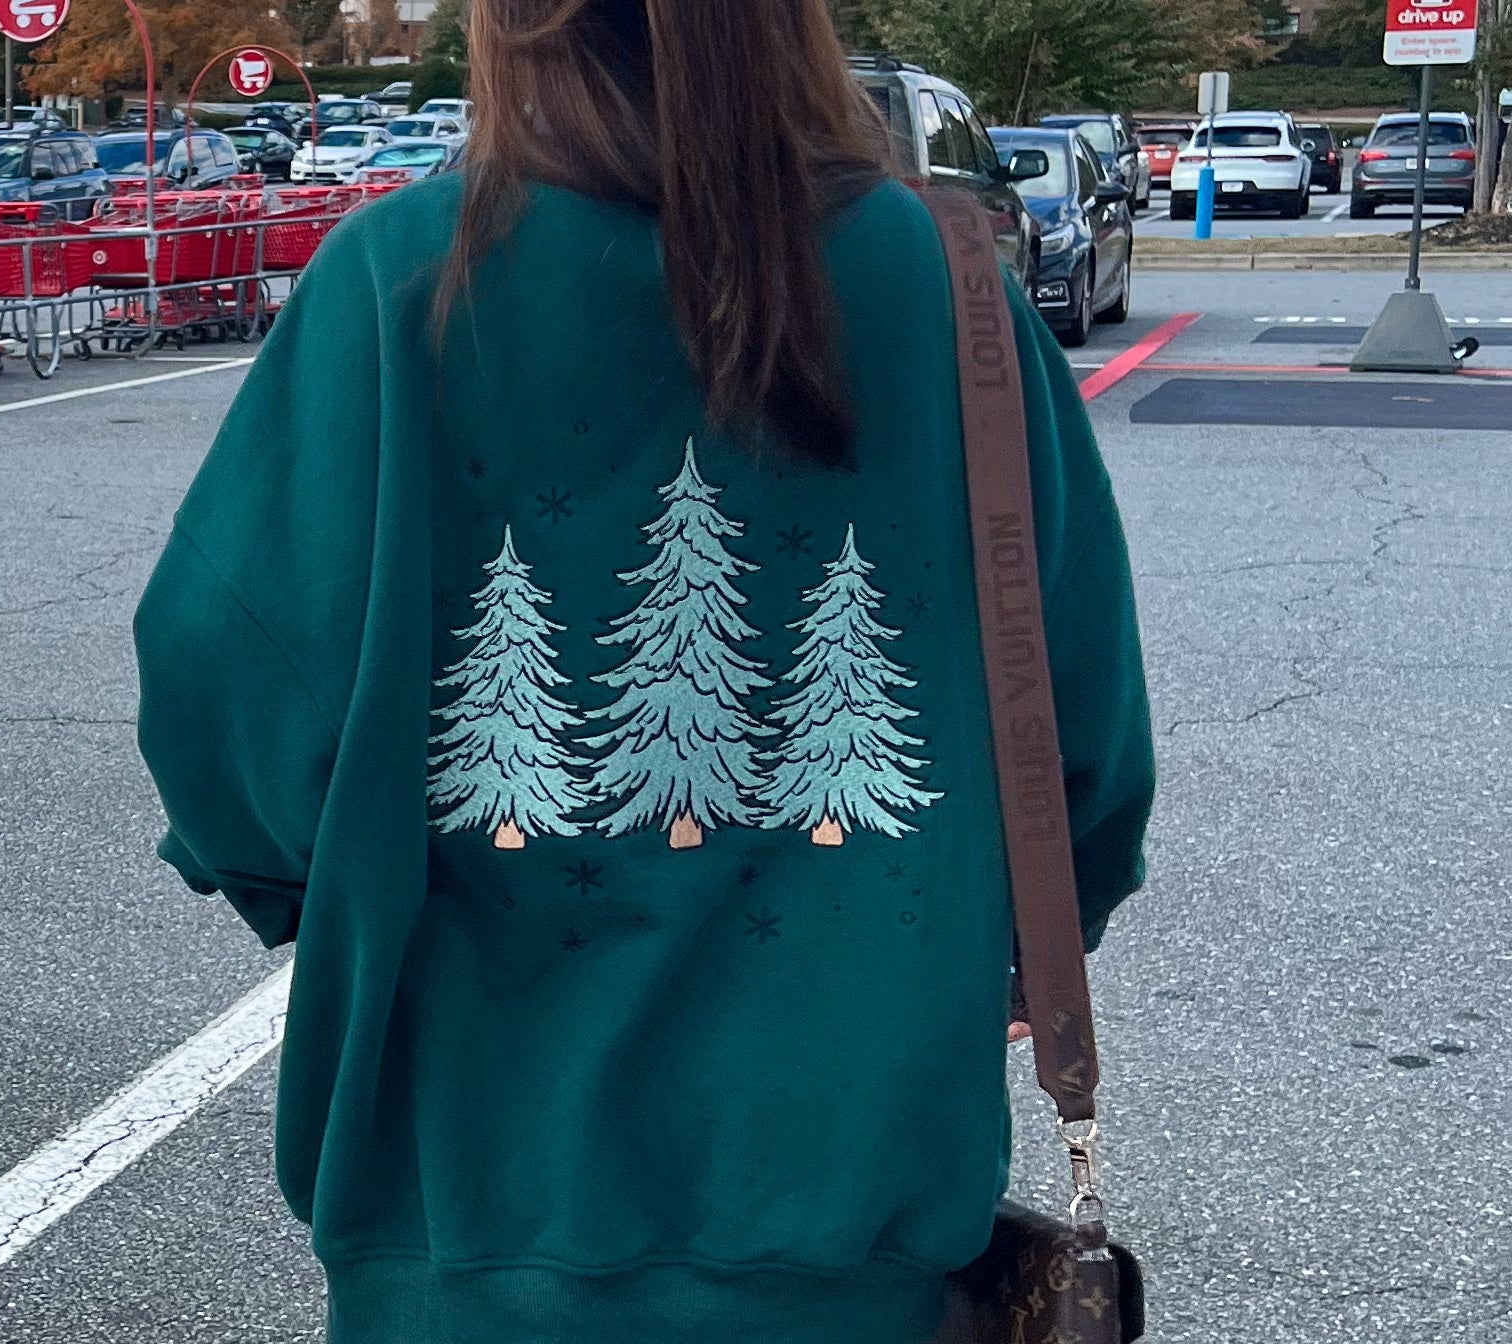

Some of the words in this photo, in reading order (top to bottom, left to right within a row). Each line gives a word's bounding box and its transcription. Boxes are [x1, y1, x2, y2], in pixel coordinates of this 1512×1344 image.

[1398, 9, 1439, 24] drive
[1442, 9, 1465, 25] up
[1401, 36, 1427, 45] Enter
[964, 272, 1009, 388] LOUIS
[988, 511, 1038, 704] VUITTON
[1010, 714, 1058, 842] LOUIS
